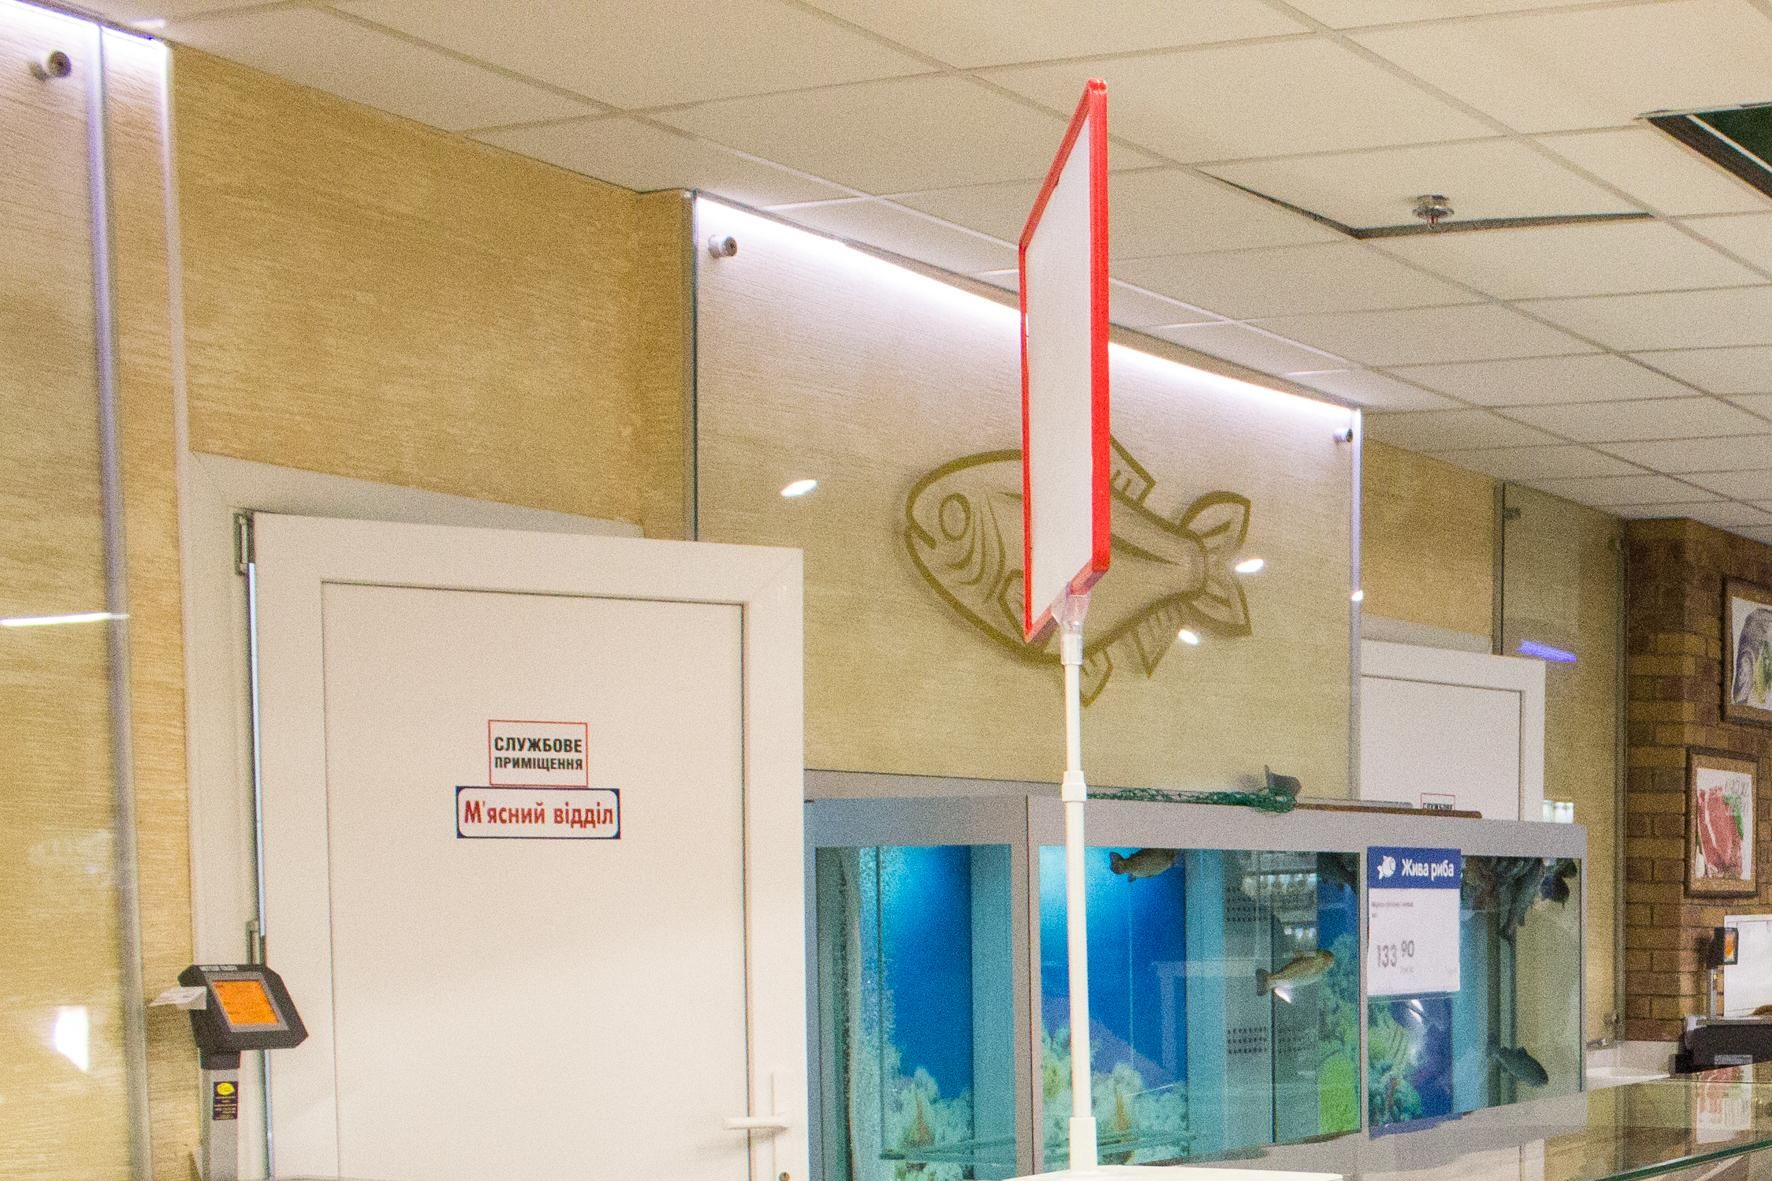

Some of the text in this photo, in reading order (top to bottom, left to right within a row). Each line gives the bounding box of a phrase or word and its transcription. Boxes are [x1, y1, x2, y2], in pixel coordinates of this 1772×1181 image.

[494, 736, 583, 753] СЛУЖБОВЕ
[494, 756, 583, 771] ПРИМІЩЕННЯ
[464, 800, 613, 828] М'ясний відділ
[1401, 858, 1455, 881] Жива риба
[1377, 944, 1397, 968] 133
